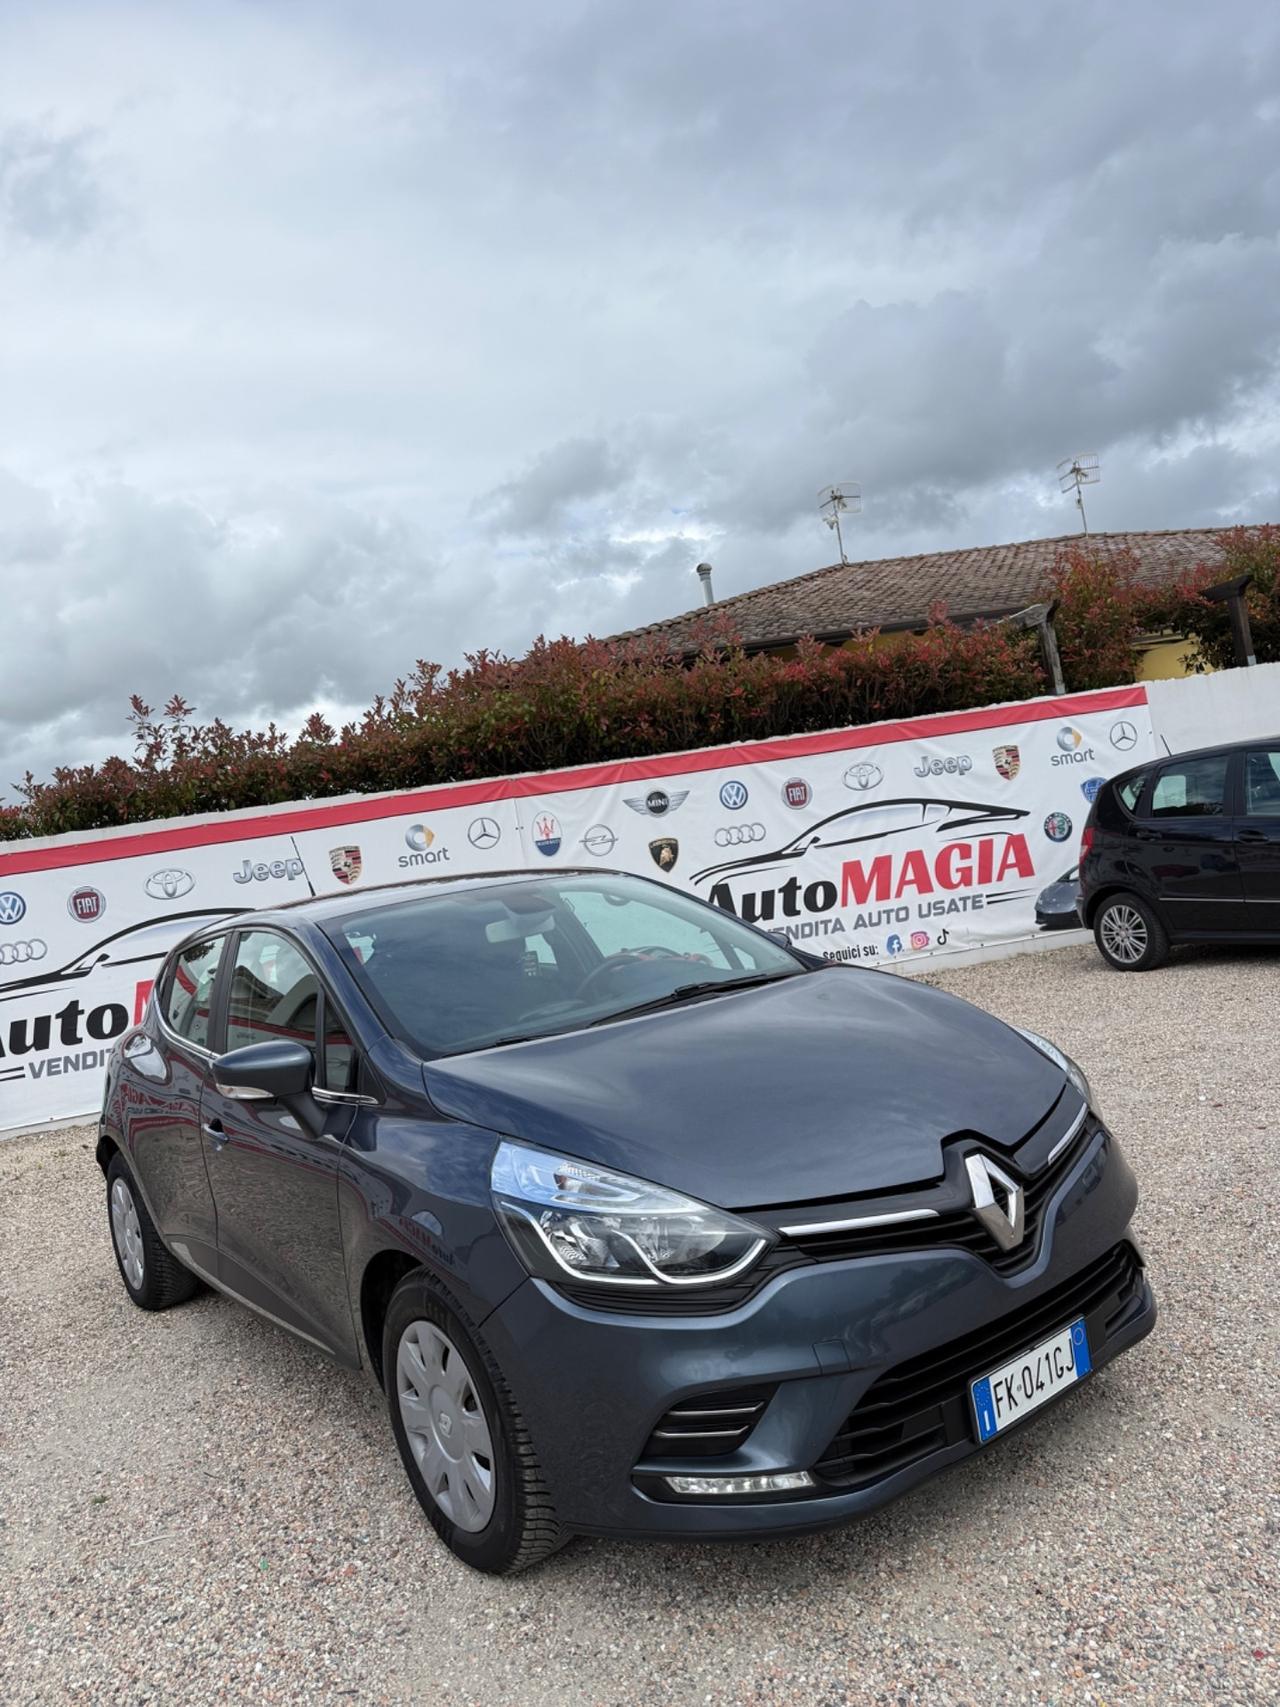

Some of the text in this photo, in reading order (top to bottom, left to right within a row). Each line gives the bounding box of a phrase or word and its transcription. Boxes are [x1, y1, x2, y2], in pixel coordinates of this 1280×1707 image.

[913, 755, 972, 778] Jeep
[1051, 748, 1095, 767] smart
[788, 786, 805, 803] FIAT
[398, 848, 451, 868] smart
[232, 858, 304, 885] Jeep
[76, 896, 97, 915] FIAT
[853, 906, 910, 931] AUTO
[918, 893, 984, 919] USATE
